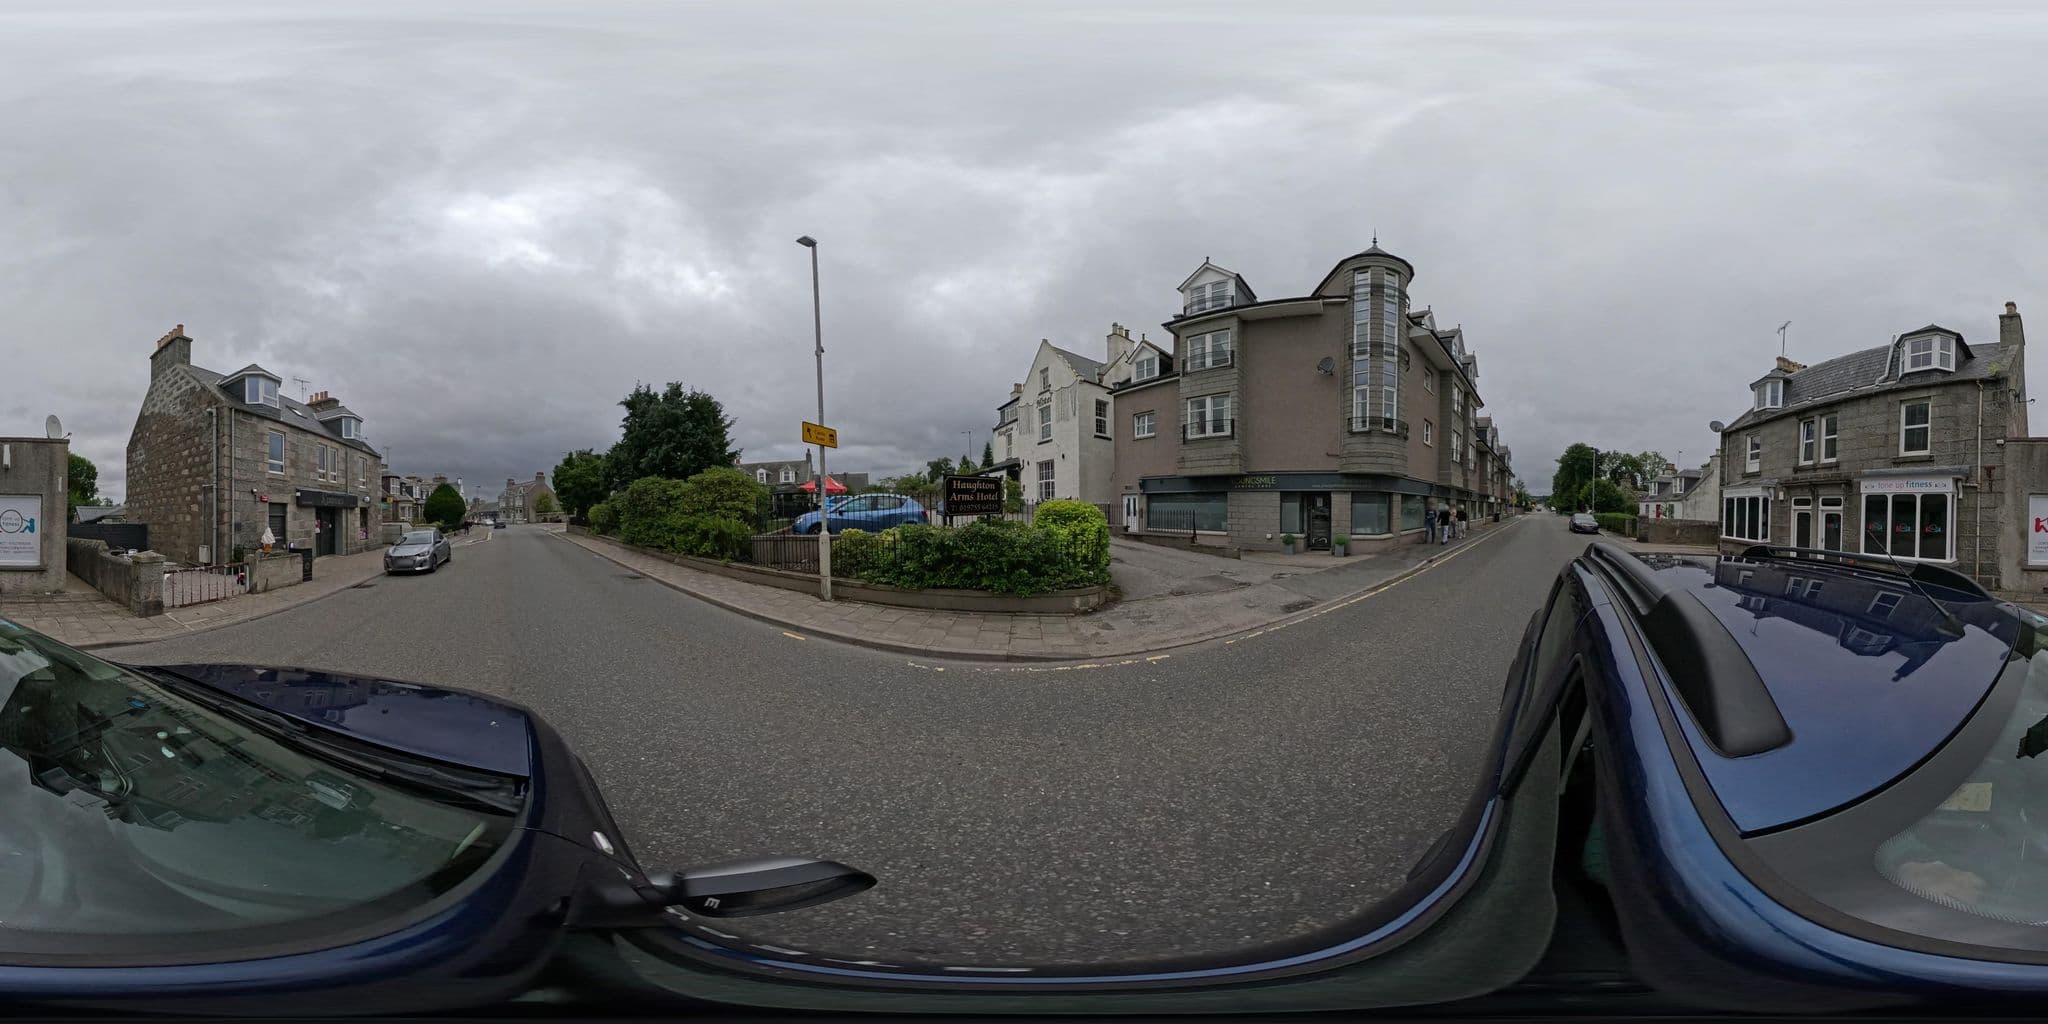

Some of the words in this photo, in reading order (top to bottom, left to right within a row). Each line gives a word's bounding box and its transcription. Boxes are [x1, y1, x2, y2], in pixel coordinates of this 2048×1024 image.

[953, 480, 995, 493] Haughton
[1906, 480, 1932, 489] fitness
[949, 492, 974, 501] Arms
[976, 492, 998, 501] Hotel
